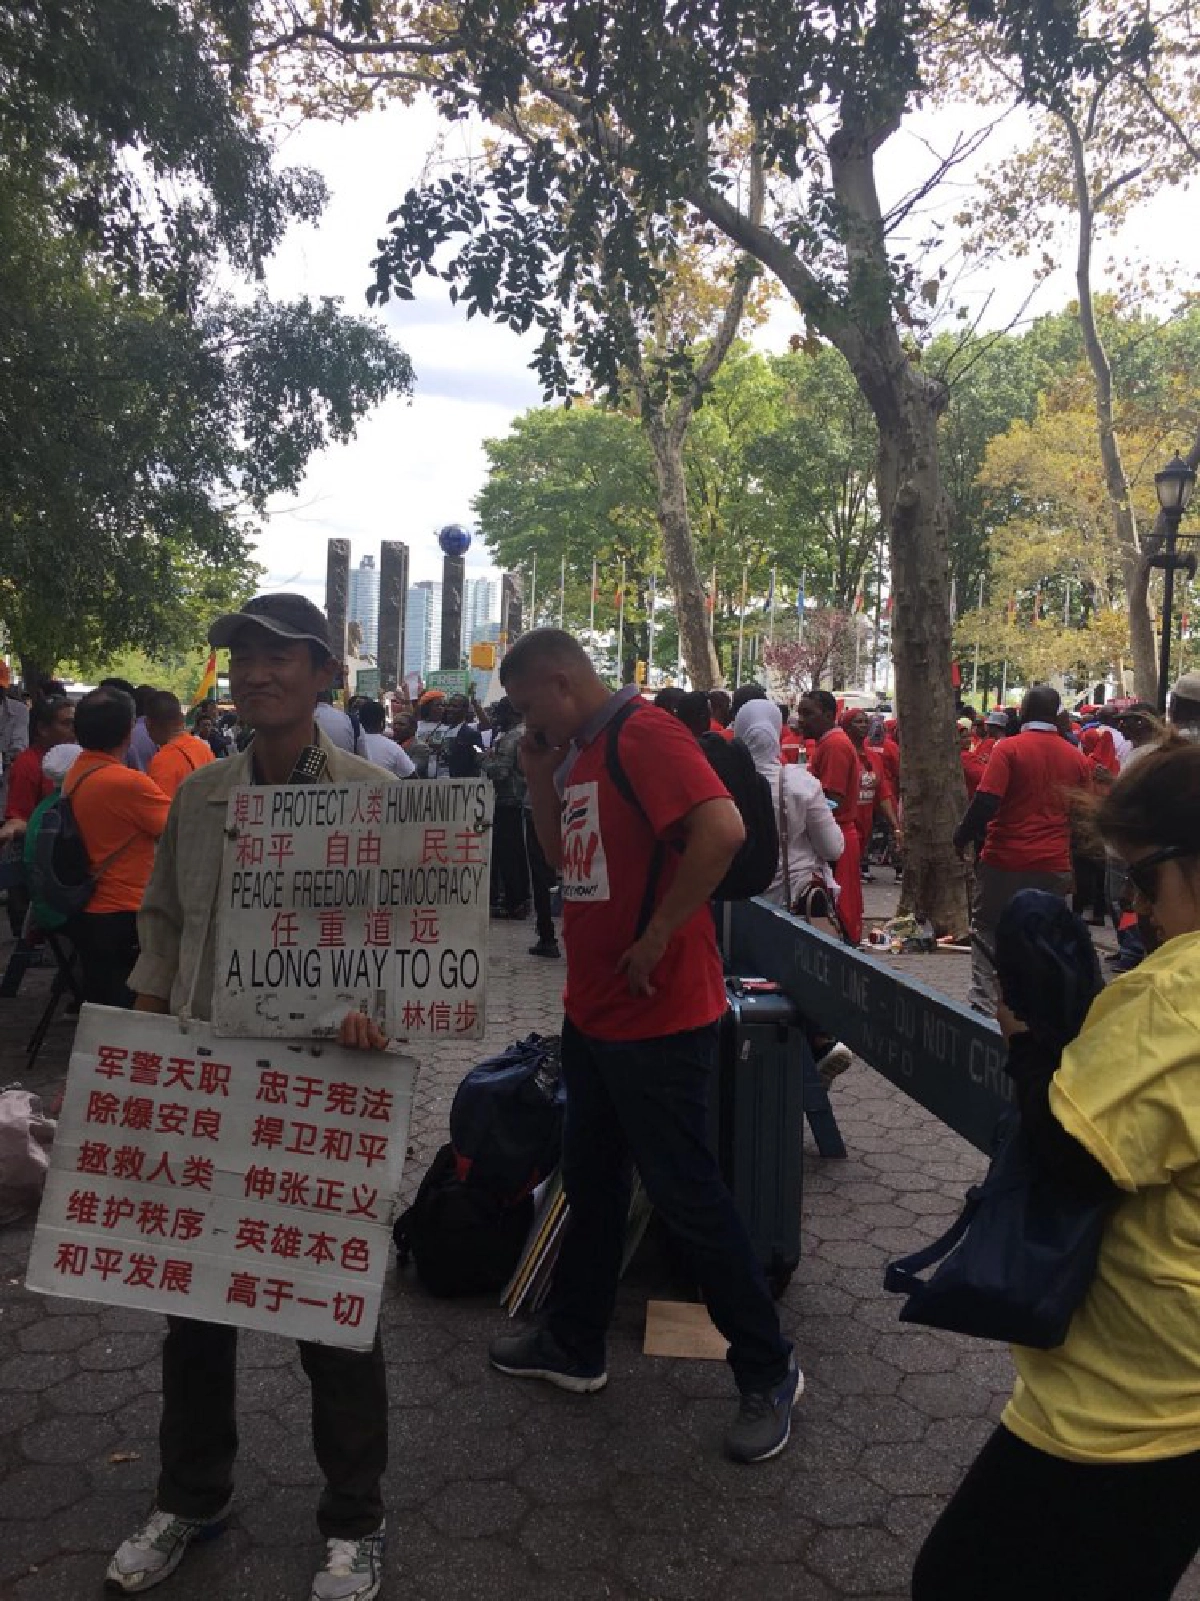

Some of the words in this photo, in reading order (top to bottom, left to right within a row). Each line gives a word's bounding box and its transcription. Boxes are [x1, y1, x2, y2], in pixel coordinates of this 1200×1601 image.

[233, 792, 264, 829] 捍卫
[272, 789, 349, 827] PROTECT
[350, 788, 382, 823] 人类
[386, 783, 486, 823] HUMANITY'S
[236, 832, 294, 869] 和平
[327, 830, 381, 867] 自由
[420, 827, 485, 865] 民主
[231, 871, 284, 909] PEACE
[292, 869, 370, 907] FREEDOM
[379, 866, 483, 906] DEMOCRACY
[271, 908, 440, 948] 任重道远
[225, 948, 243, 988] A
[251, 948, 321, 988] LONG
[331, 948, 389, 988] WAY
[395, 948, 430, 989] TO
[438, 948, 480, 989] GO
[402, 1000, 478, 1032] 林信步
[794, 938, 830, 986] POLICE
[841, 962, 870, 1012] LINE
[895, 996, 916, 1039] DO
[923, 1009, 961, 1068] NOT
[968, 1037, 1014, 1103] CRO
[95, 1046, 232, 1097] 军警天职
[256, 1071, 394, 1123] 忠于宪法
[86, 1090, 222, 1141] 除爆安良
[251, 1114, 389, 1168] 捍卫和平
[77, 1139, 215, 1191] 拯救人类
[244, 1164, 378, 1220] 伸张正义
[65, 1189, 206, 1241] 维护秩序
[235, 1216, 369, 1273] 英雄本色
[54, 1243, 193, 1294] 和平发展
[226, 1271, 365, 1328] 高于一切
